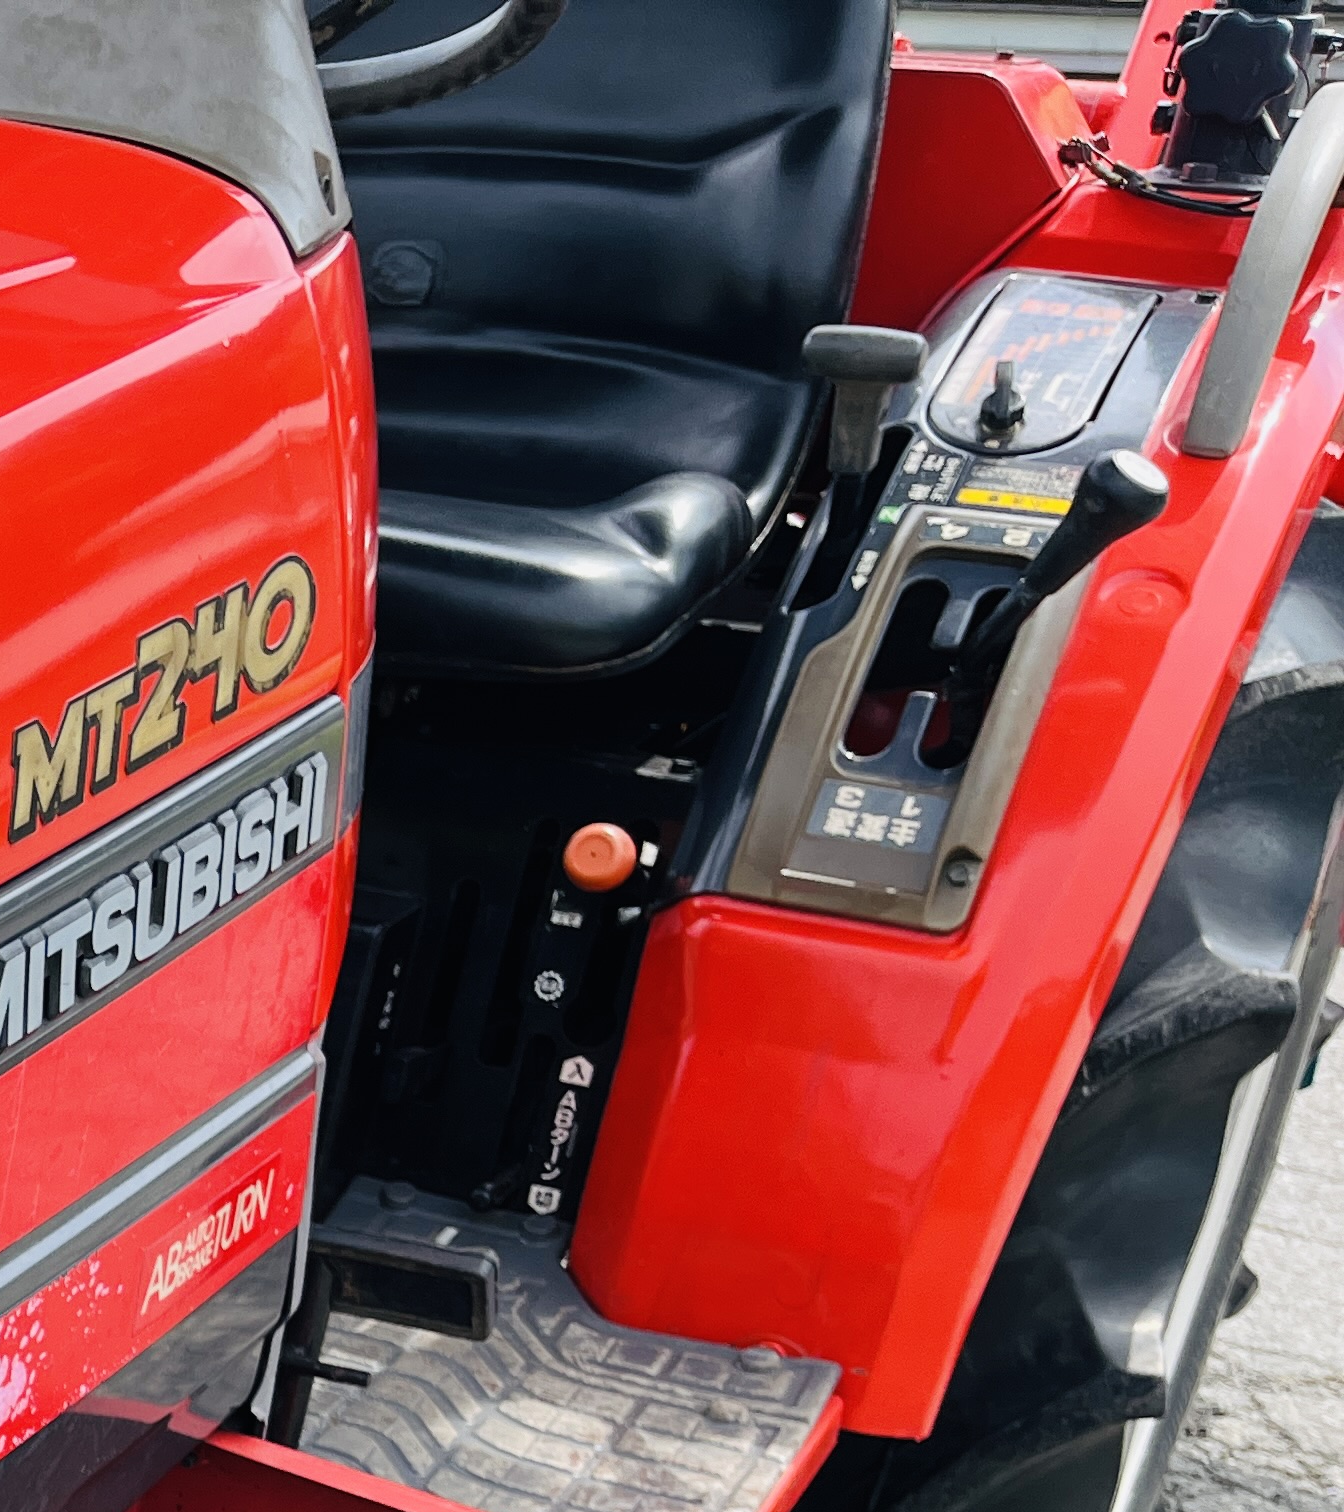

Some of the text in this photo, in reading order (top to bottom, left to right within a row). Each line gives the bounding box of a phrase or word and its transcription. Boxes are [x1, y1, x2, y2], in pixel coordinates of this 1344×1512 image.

[8, 555, 317, 843] MT240
[835, 785, 865, 808] 3
[540, 1089, 577, 1181] ABターン
[212, 1168, 275, 1260] TURN
